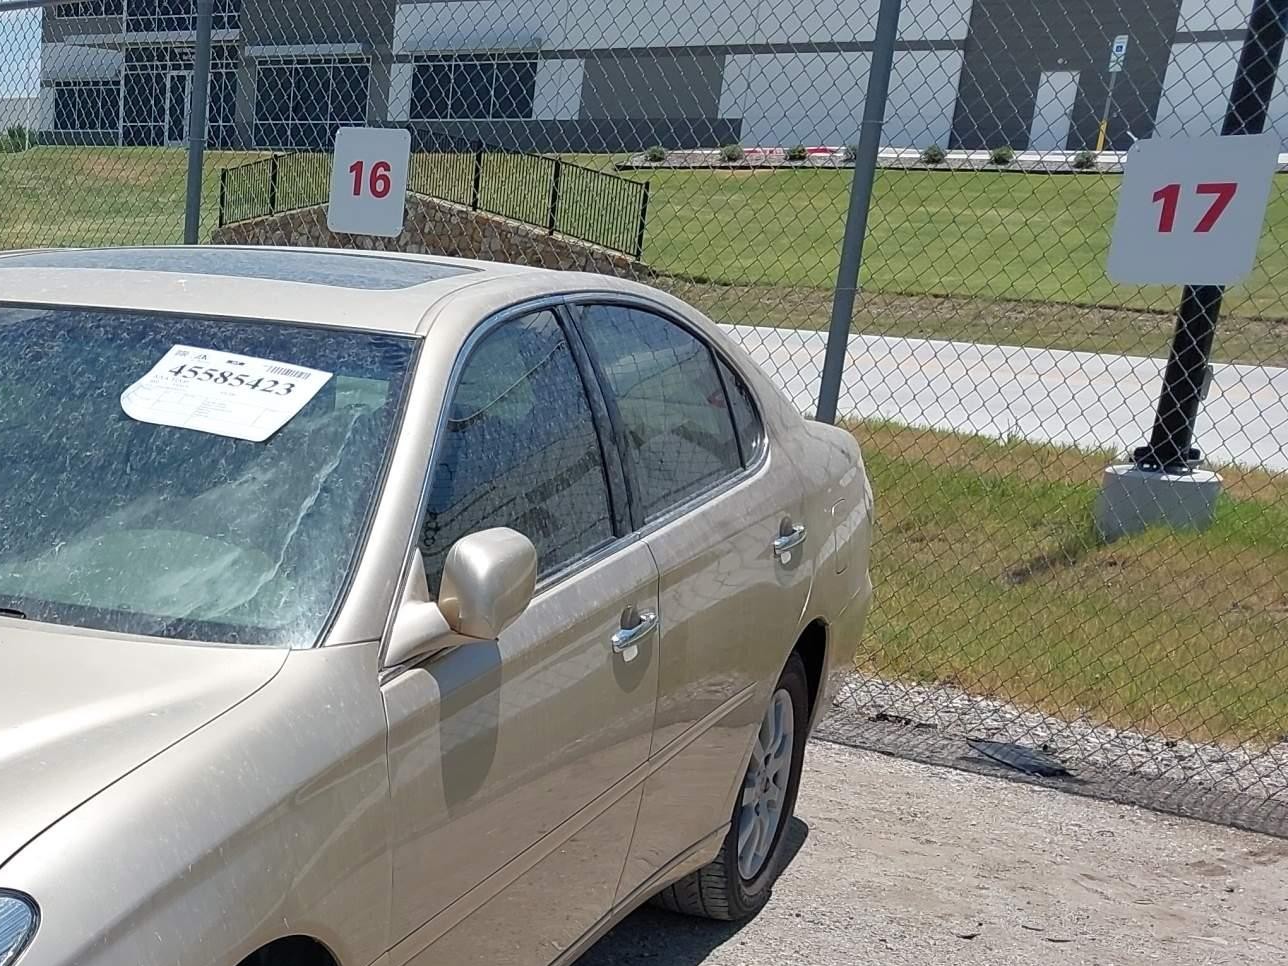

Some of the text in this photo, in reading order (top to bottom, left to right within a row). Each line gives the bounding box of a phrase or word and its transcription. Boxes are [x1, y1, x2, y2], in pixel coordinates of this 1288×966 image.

[348, 160, 392, 199] 16
[1151, 182, 1239, 233] 17
[168, 363, 297, 397] 45585423
